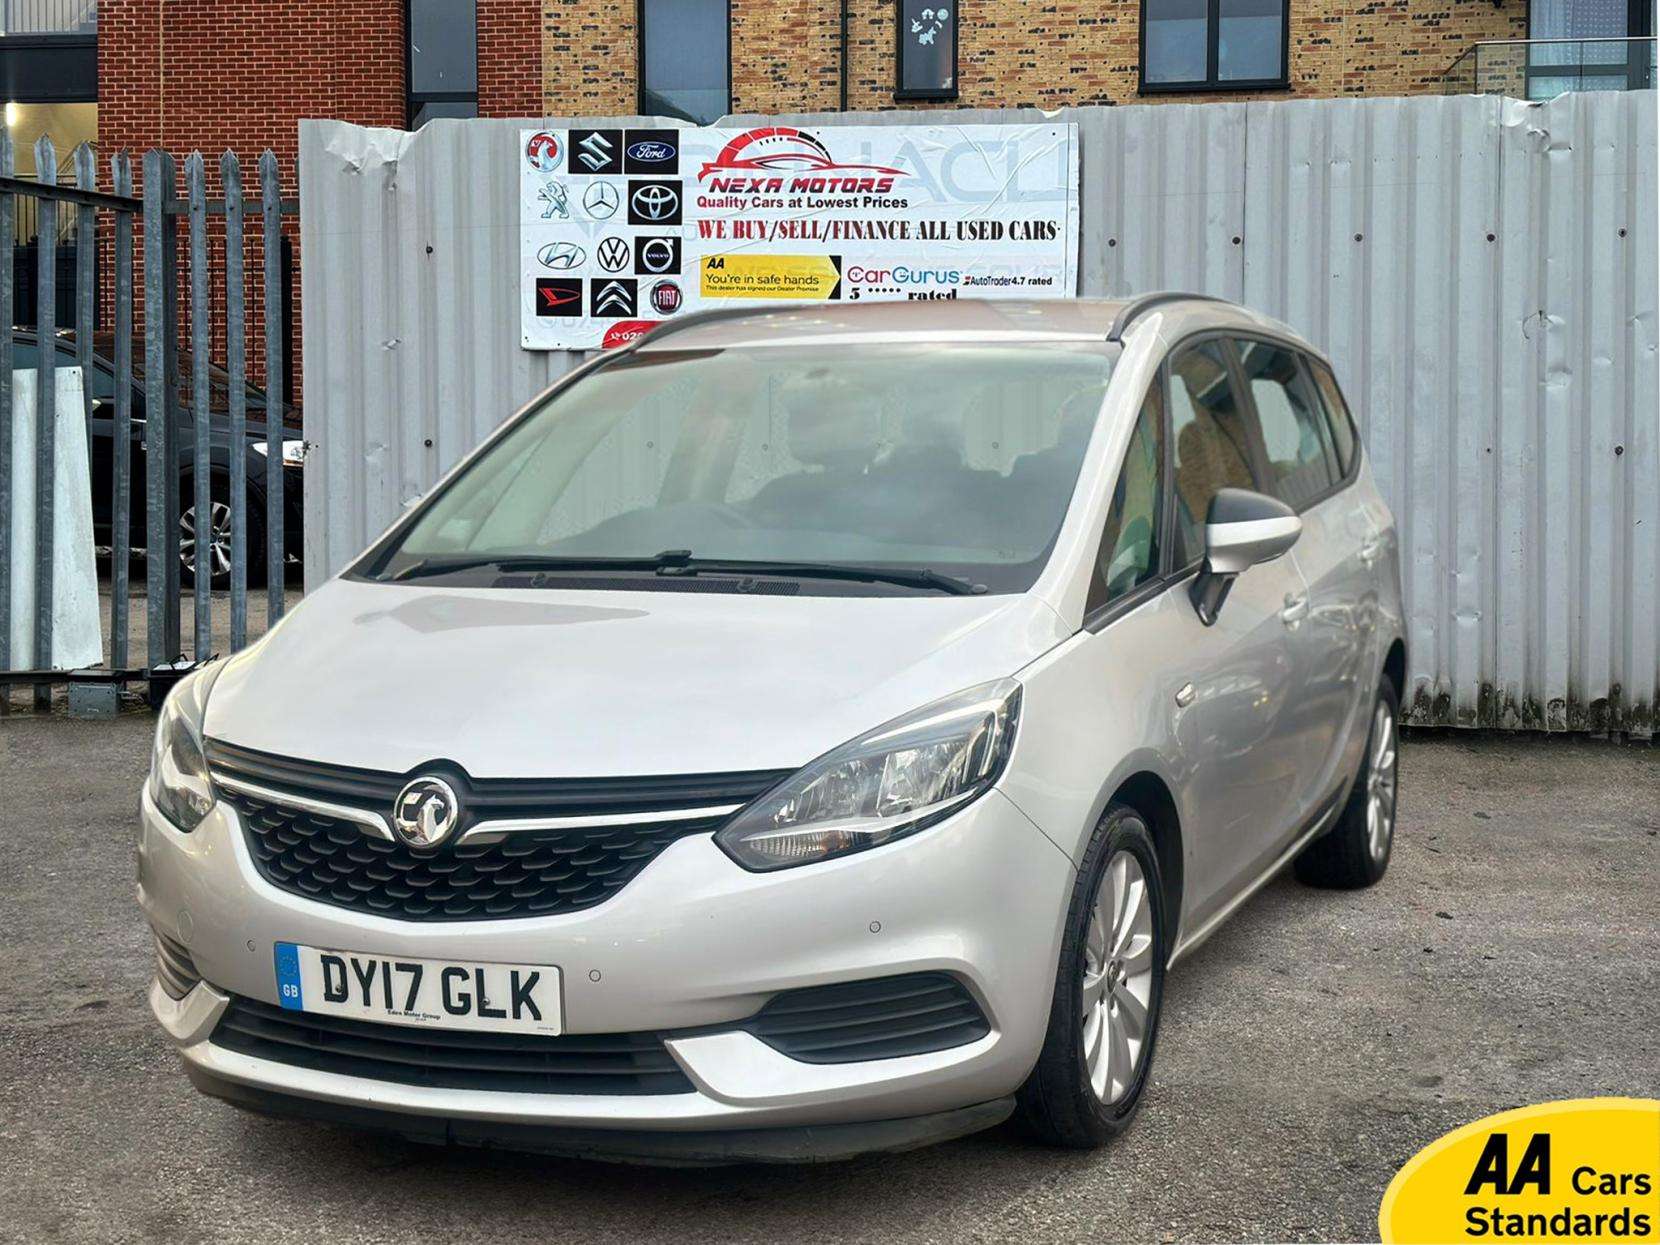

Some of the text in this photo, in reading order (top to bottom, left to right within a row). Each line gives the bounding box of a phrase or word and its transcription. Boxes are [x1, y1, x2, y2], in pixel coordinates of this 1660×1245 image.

[636, 144, 665, 158] Ford
[709, 178, 895, 193] NEXA MOTORS
[697, 195, 908, 211] Quality Cars at Lowest Prices
[697, 219, 726, 239] WE
[732, 219, 911, 242] BUY/SELL/FINANCE
[916, 220, 951, 240] ALL
[956, 220, 1003, 240] USED
[1009, 220, 1057, 240] CARS
[706, 257, 725, 269] AA
[706, 273, 820, 285] You're in safe hands
[847, 266, 960, 284] CarGurus
[1028, 277, 1052, 286] rated
[658, 290, 675, 305] FIAT
[849, 287, 957, 300] 5 rated
[283, 983, 298, 998] GB
[320, 954, 542, 1021] DY17 GLK
